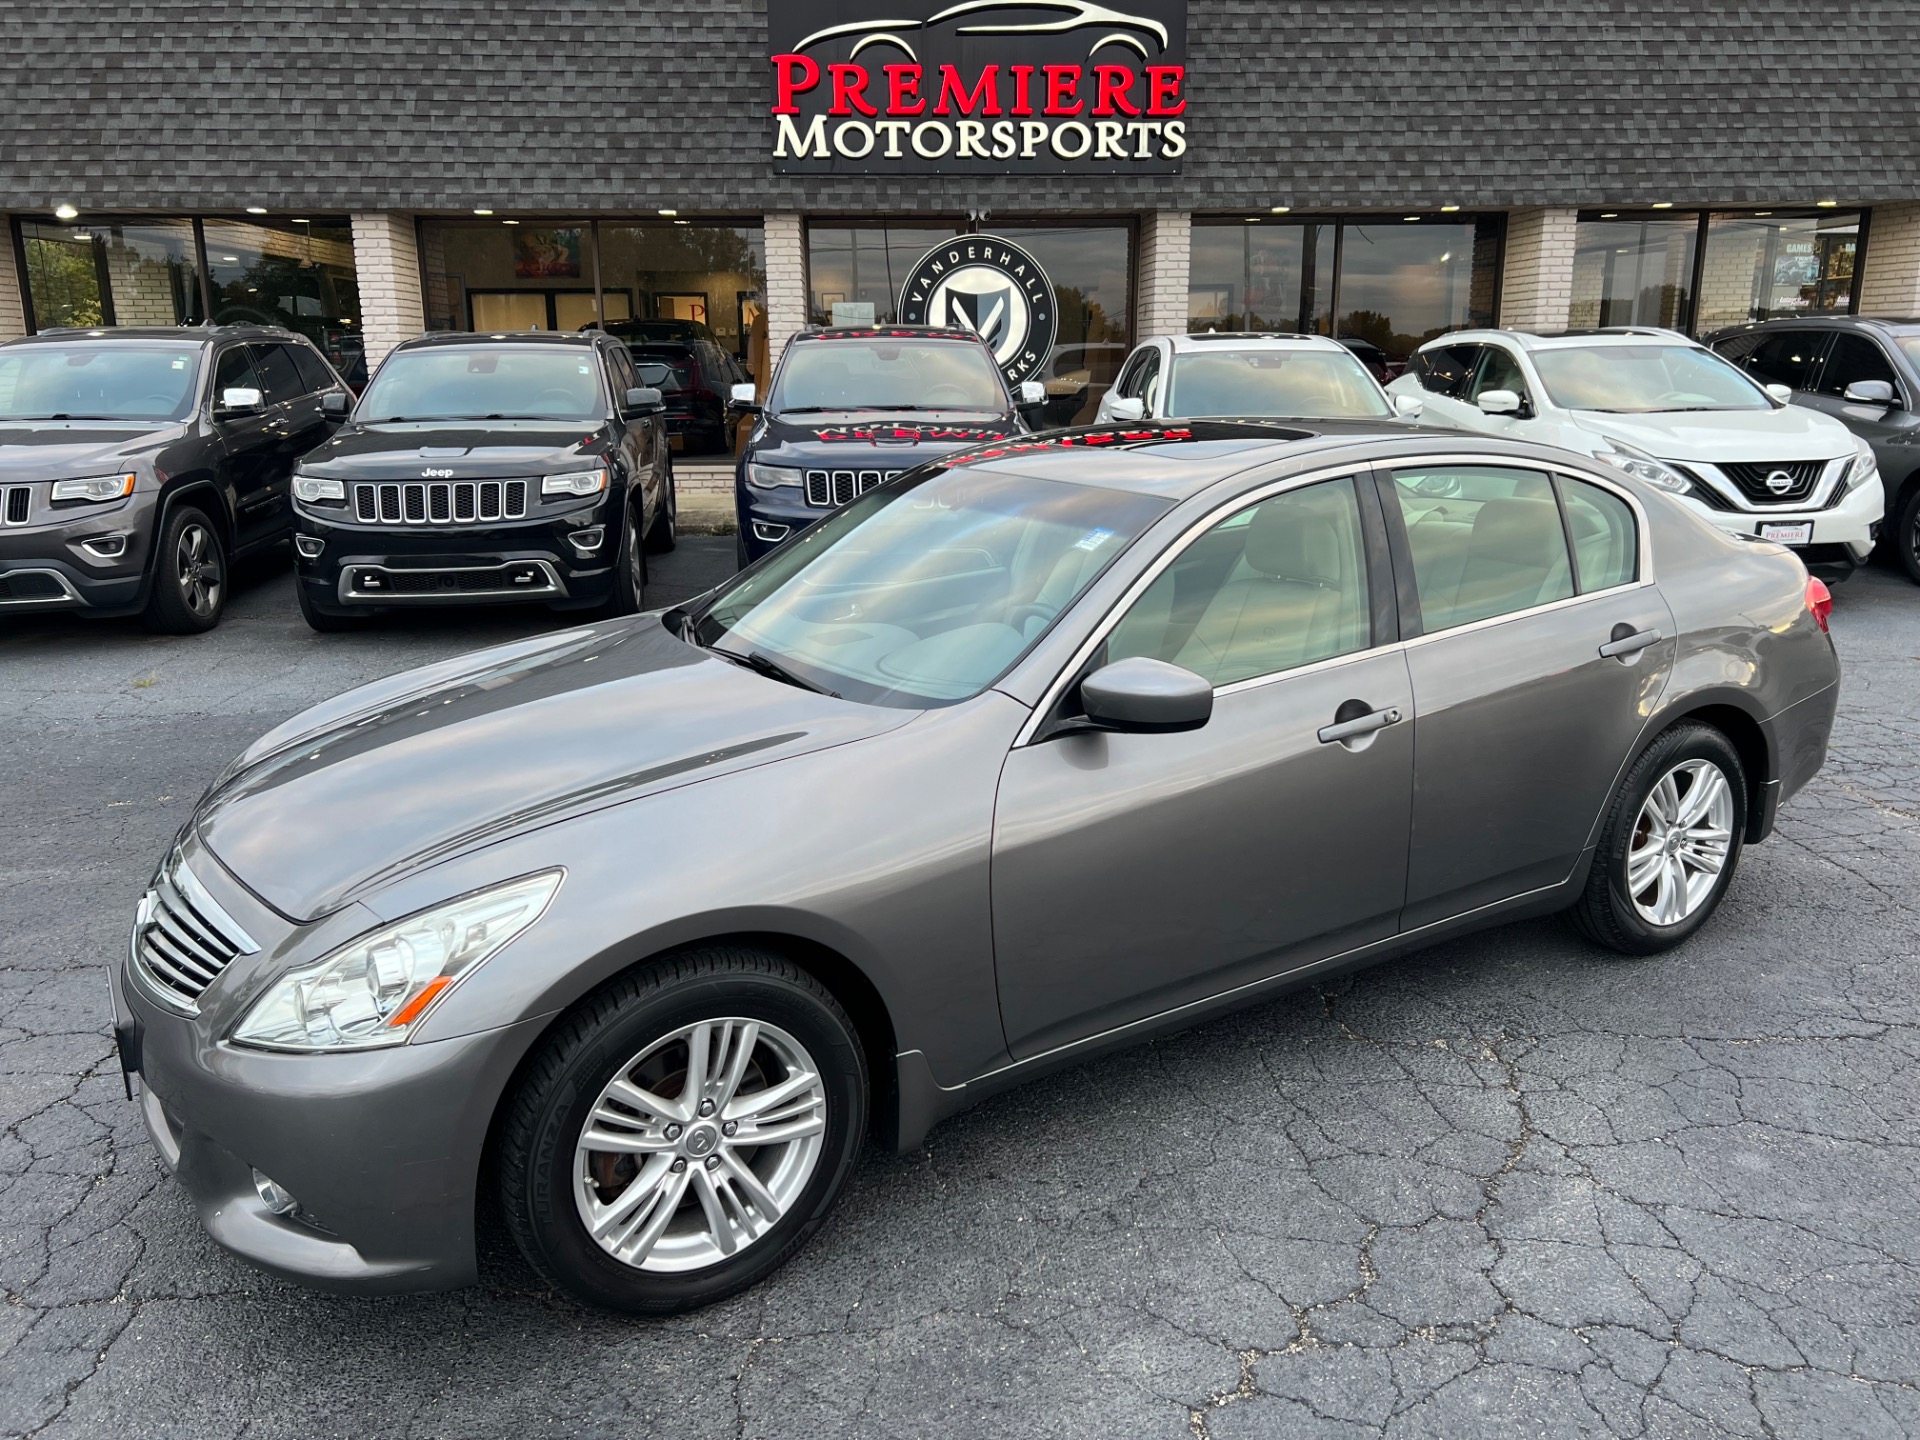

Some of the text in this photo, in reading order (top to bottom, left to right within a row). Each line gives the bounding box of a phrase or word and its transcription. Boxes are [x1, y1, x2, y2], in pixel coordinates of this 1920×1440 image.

[771, 53, 1187, 115] PREMIERE
[772, 115, 1187, 159] MOTORSPORTS
[1786, 243, 1812, 253] GAMES
[912, 246, 1044, 303] VANDERHALL
[1007, 350, 1037, 381] RKS
[421, 467, 454, 478] Jeep
